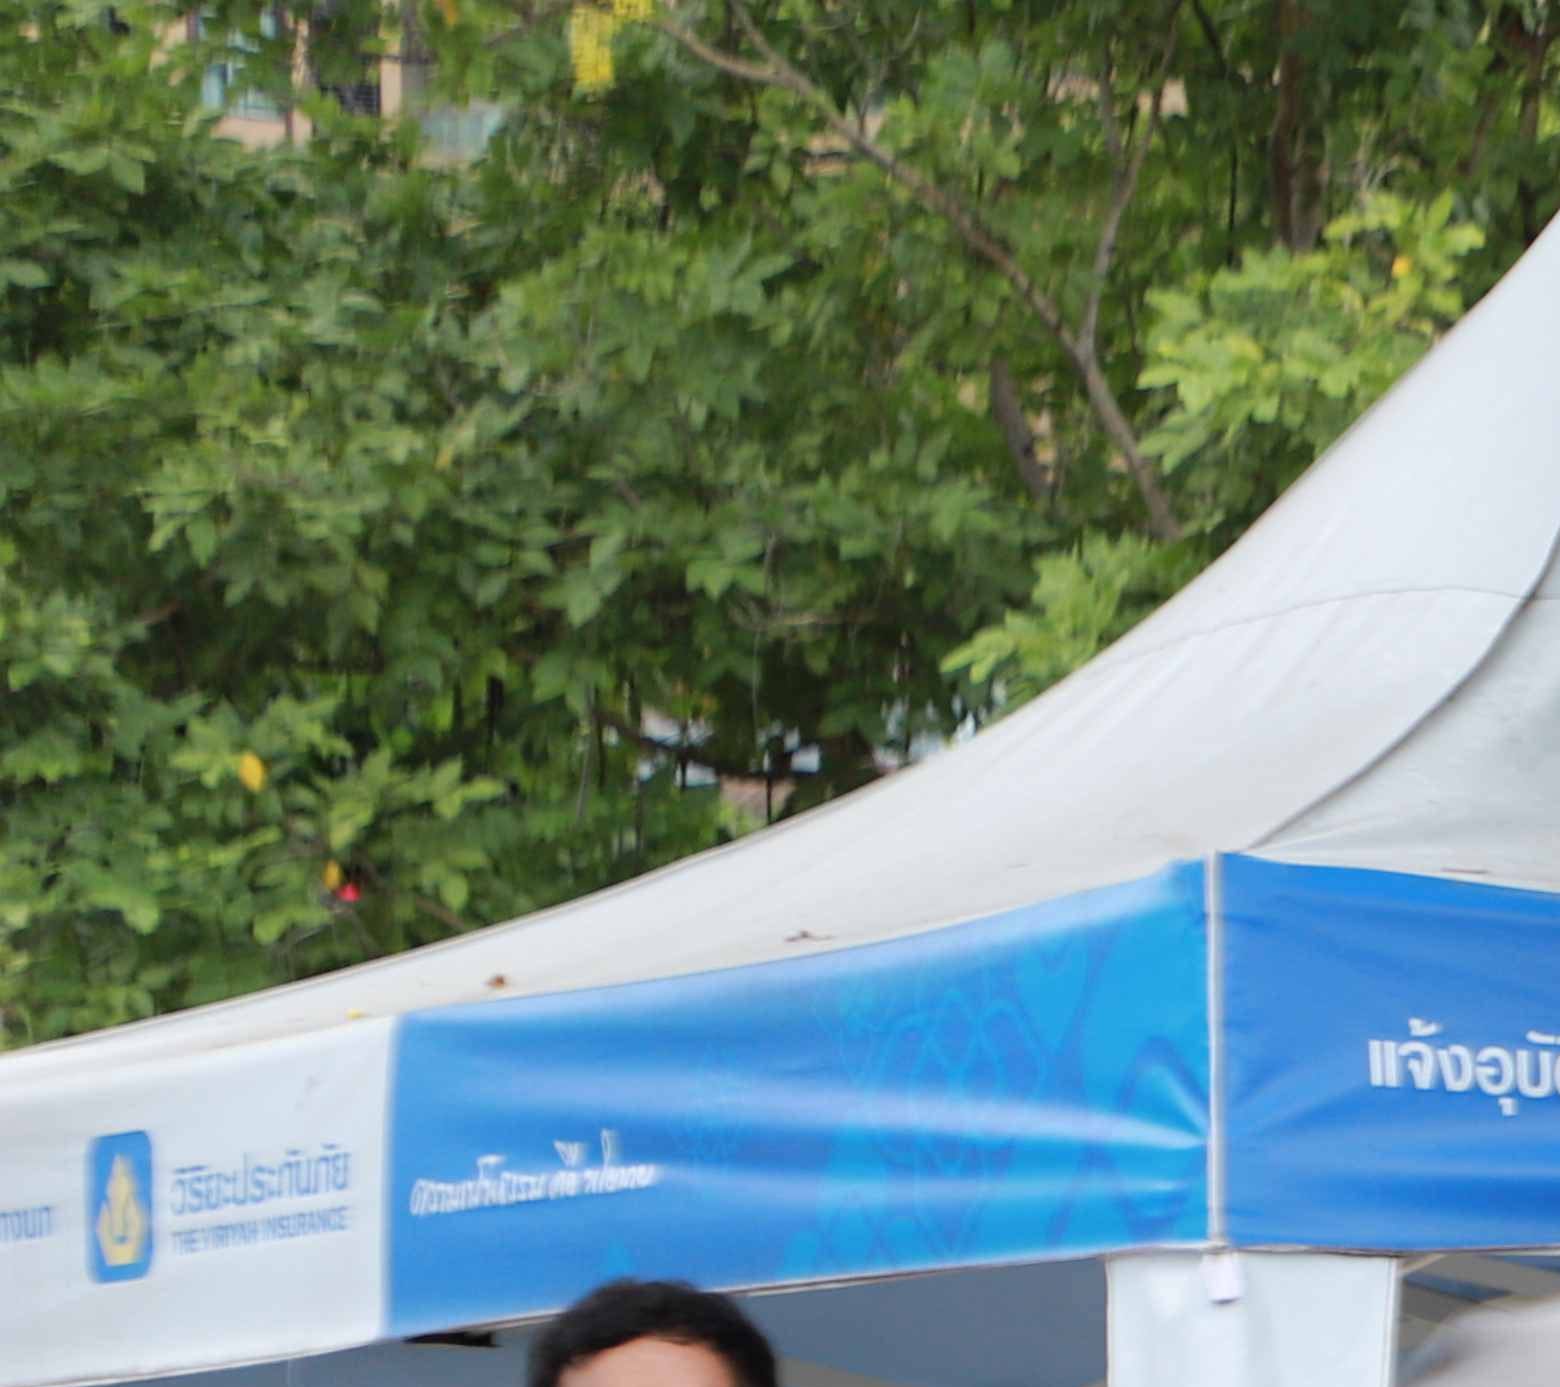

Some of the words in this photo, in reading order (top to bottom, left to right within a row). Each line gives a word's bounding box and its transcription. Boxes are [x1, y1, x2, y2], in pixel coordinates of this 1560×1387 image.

[170, 1143, 352, 1215] วิริยะประกันภัย
